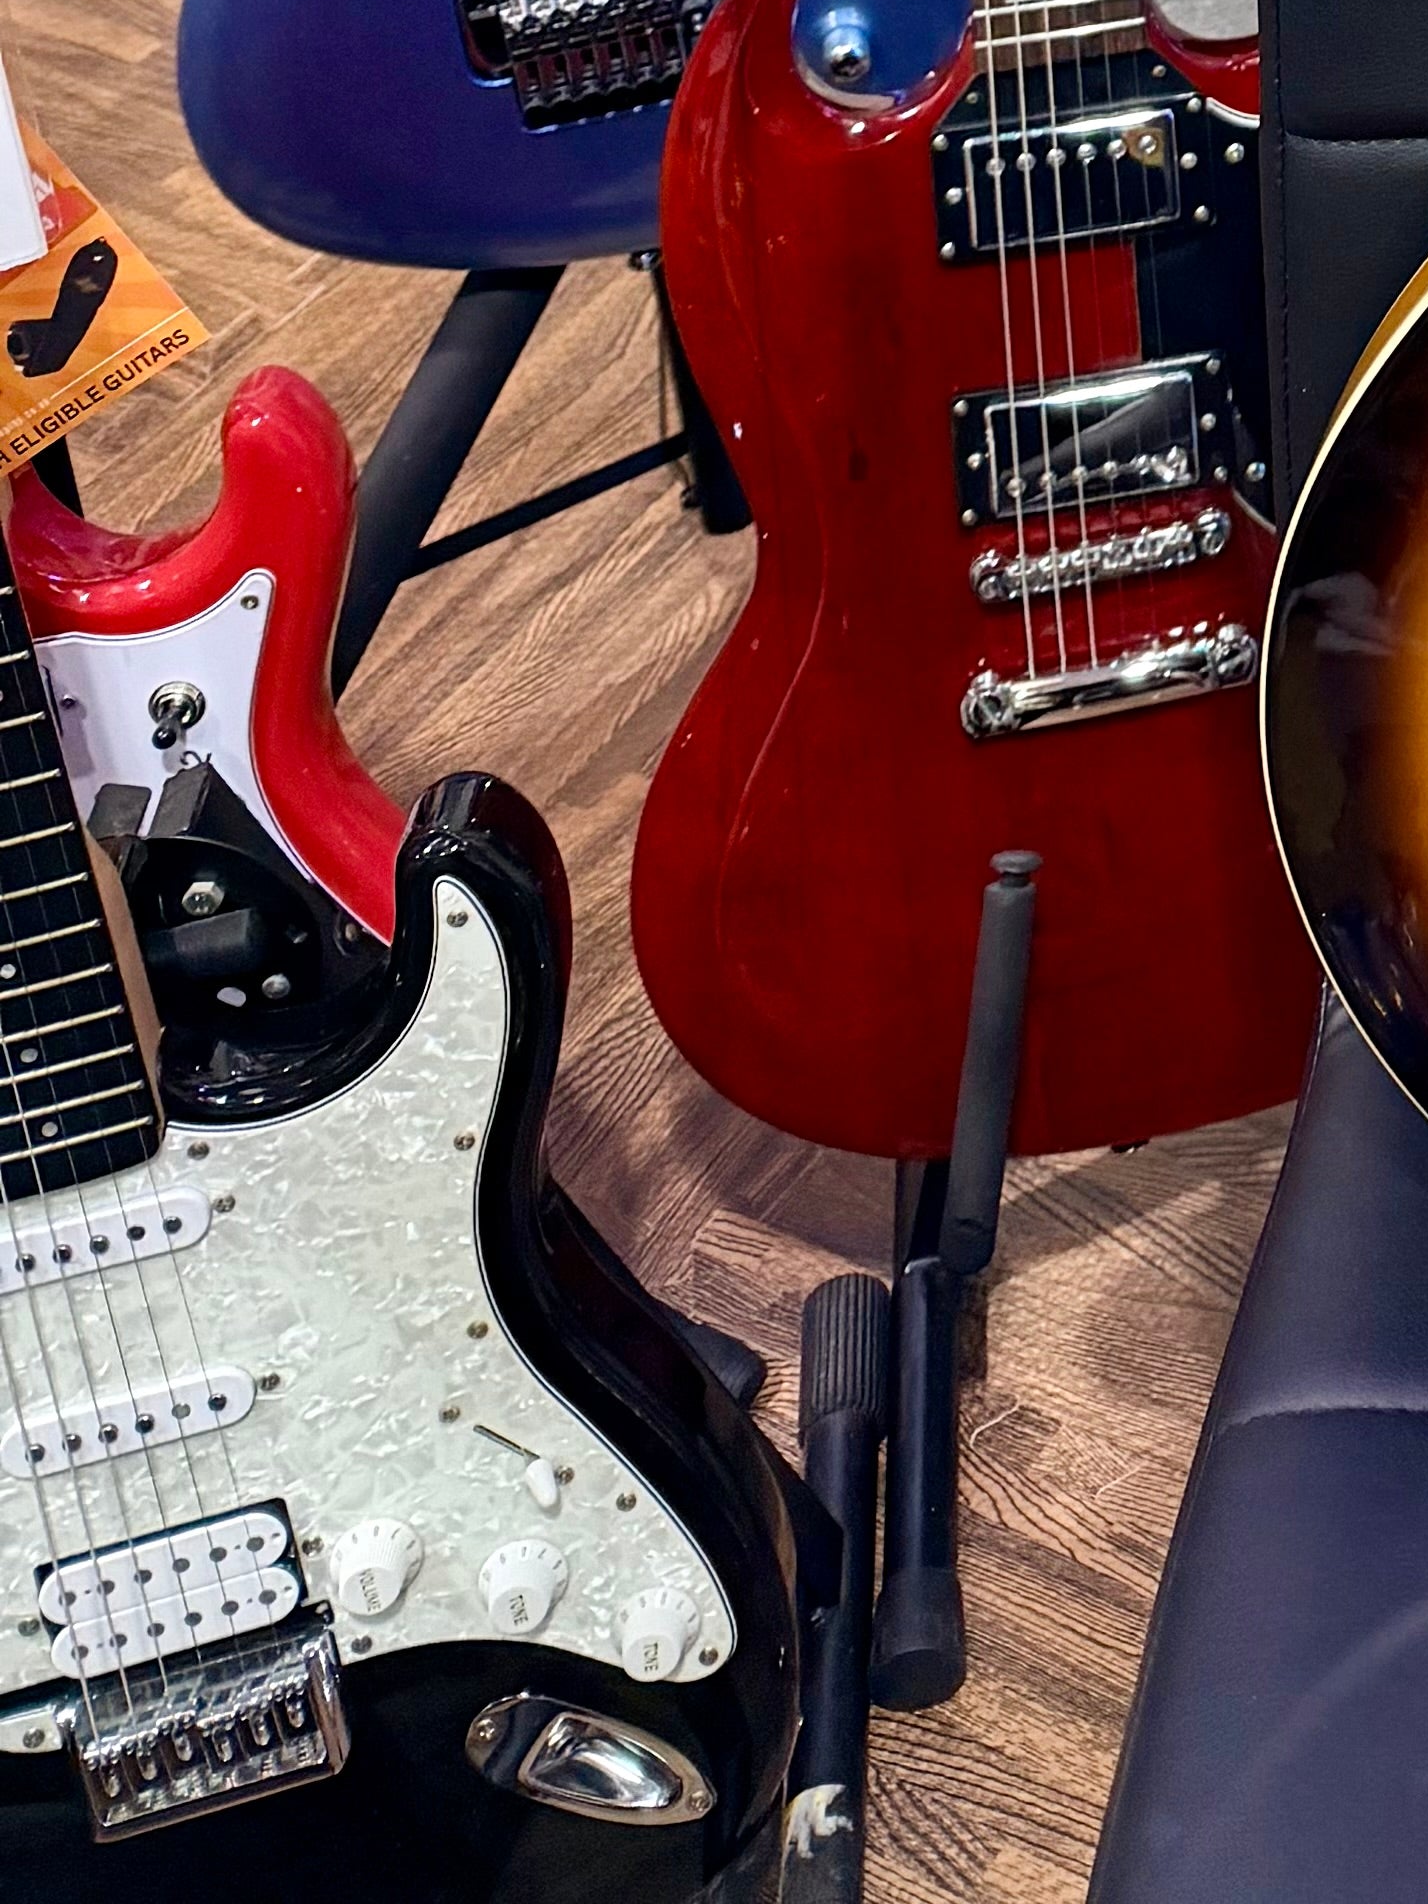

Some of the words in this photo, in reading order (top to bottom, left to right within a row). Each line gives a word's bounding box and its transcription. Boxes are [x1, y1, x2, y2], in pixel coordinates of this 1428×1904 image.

[9, 385, 105, 456] ELIGIBLE
[102, 329, 190, 391] GUITARS
[510, 1594, 529, 1626] TONE
